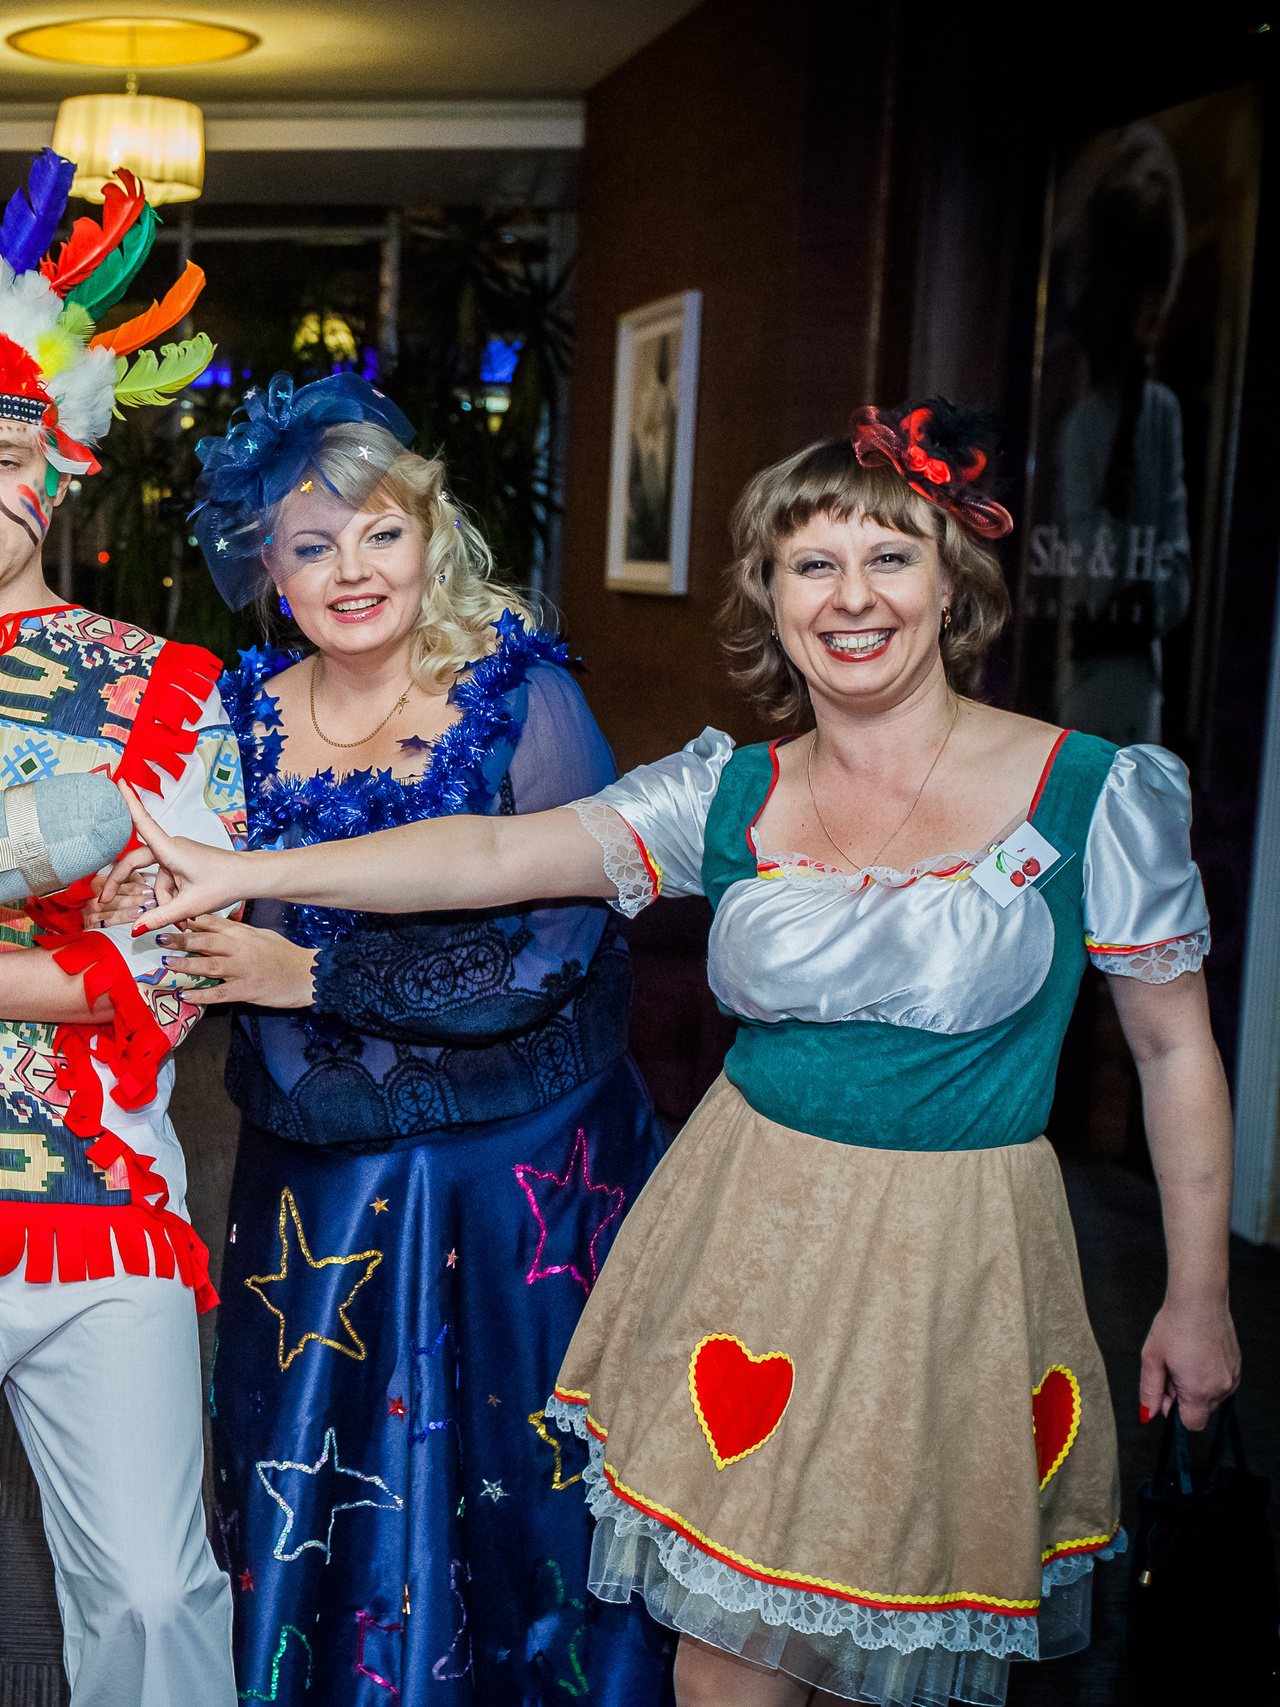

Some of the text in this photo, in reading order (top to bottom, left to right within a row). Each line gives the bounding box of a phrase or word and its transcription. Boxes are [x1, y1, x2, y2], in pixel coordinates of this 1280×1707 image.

[1030, 524, 1175, 579] She & He
